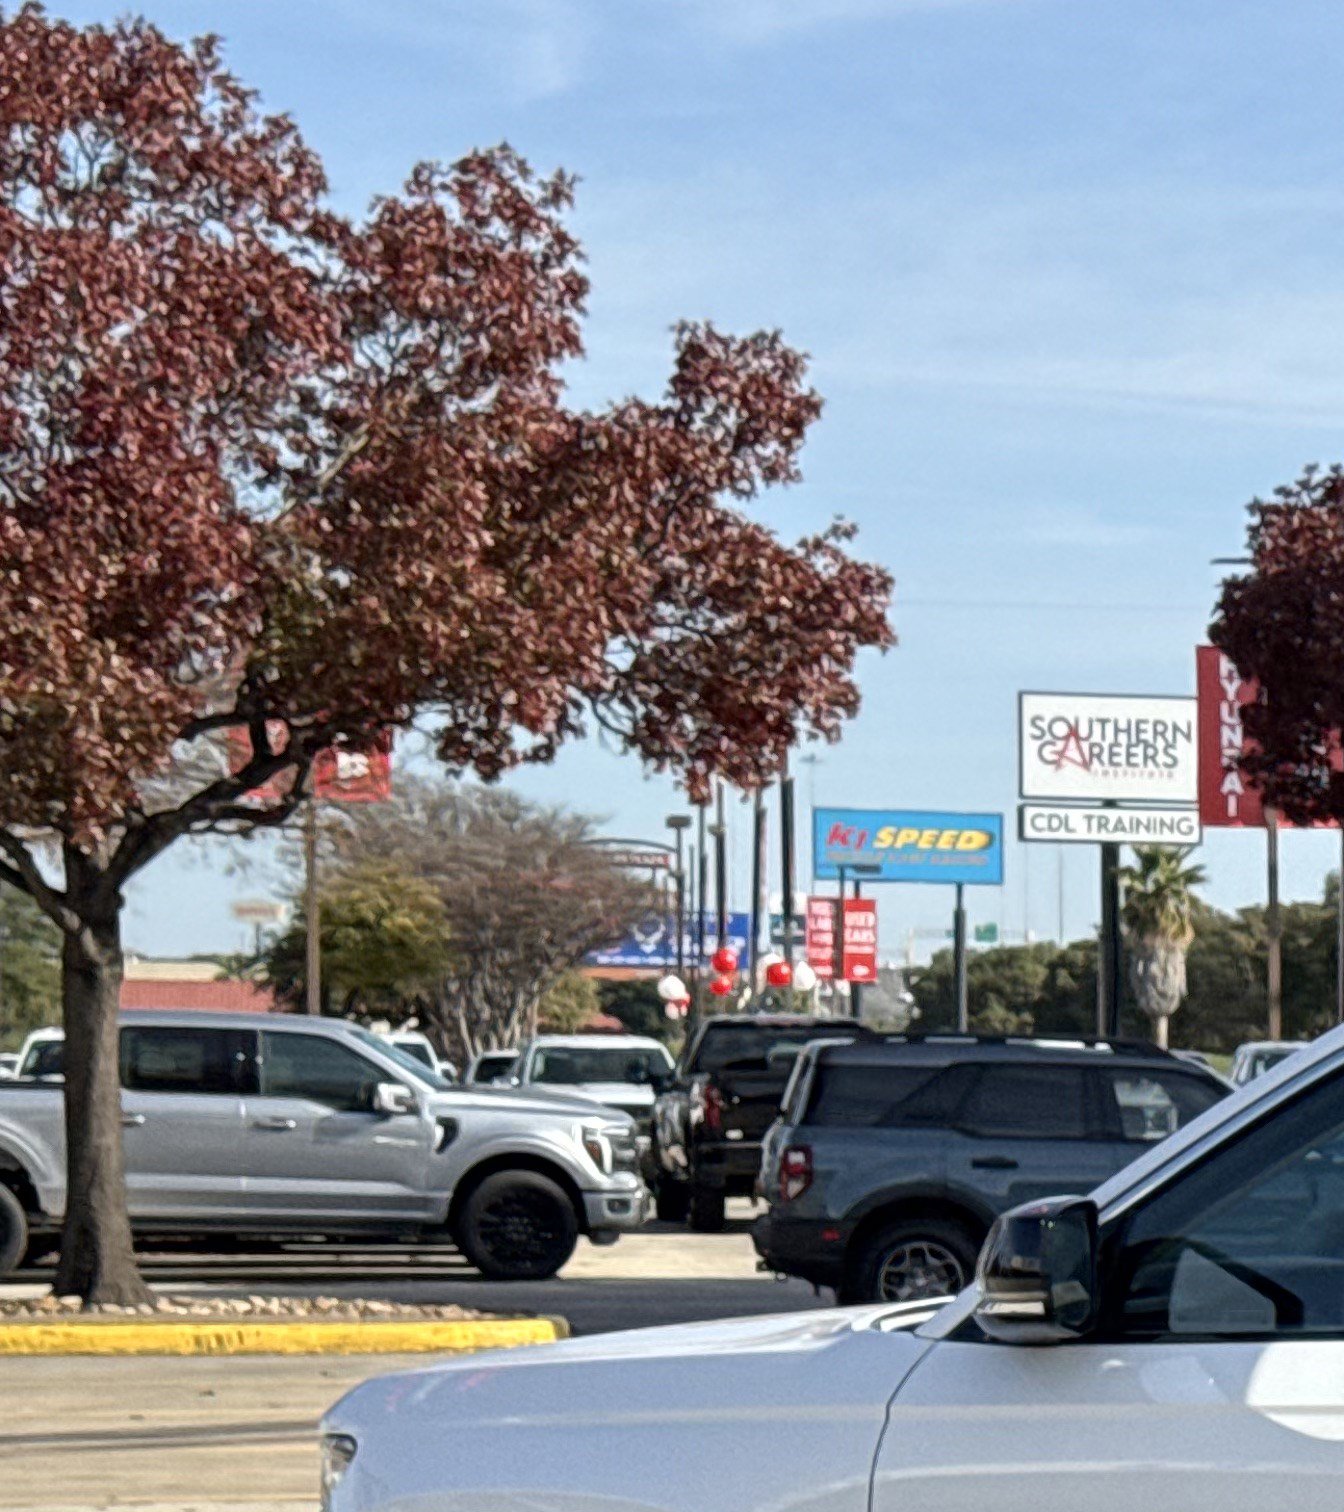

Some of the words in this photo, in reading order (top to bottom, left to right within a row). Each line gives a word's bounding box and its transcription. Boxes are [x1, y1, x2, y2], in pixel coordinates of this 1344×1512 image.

[1029, 714, 1193, 747] SOUTHERN
[1030, 812, 1077, 834] CDL
[1083, 814, 1195, 837] TRAINING
[872, 826, 994, 851] SPEED
